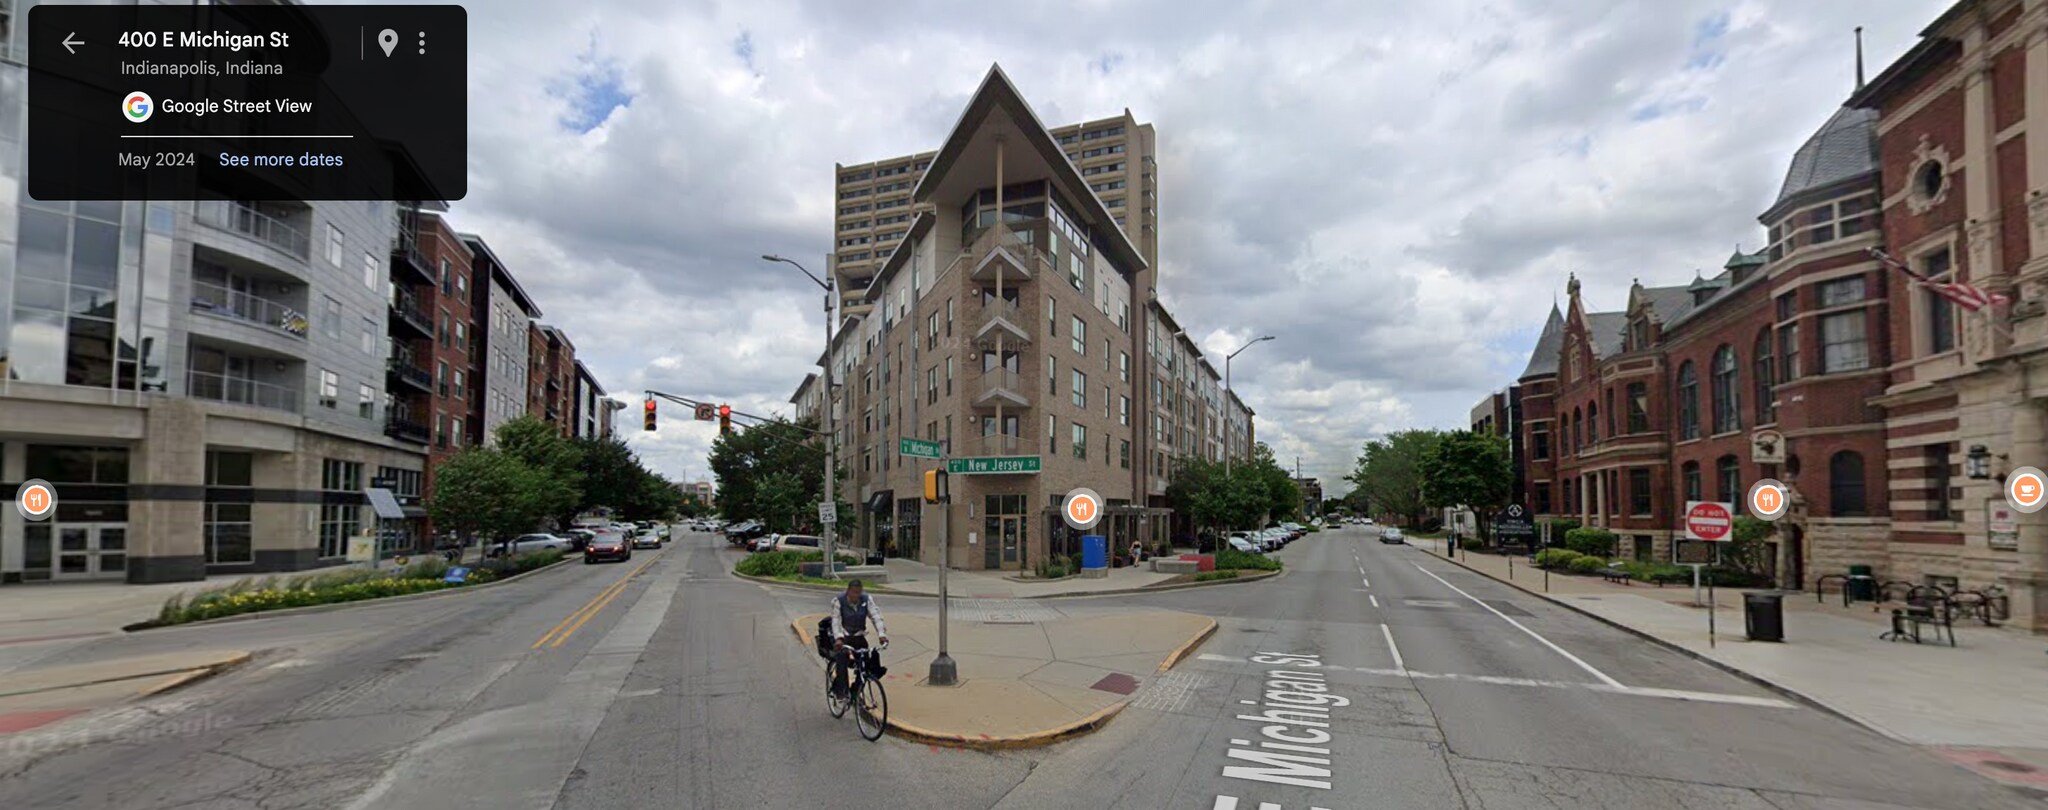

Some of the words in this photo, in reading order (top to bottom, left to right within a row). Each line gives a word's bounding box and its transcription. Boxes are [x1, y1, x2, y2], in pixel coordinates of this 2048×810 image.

[911, 441, 934, 456] Michigan
[968, 459, 987, 471] New
[992, 458, 1024, 472] Jersey
[822, 512, 834, 520] 25
[1695, 526, 1721, 534] ENTER
